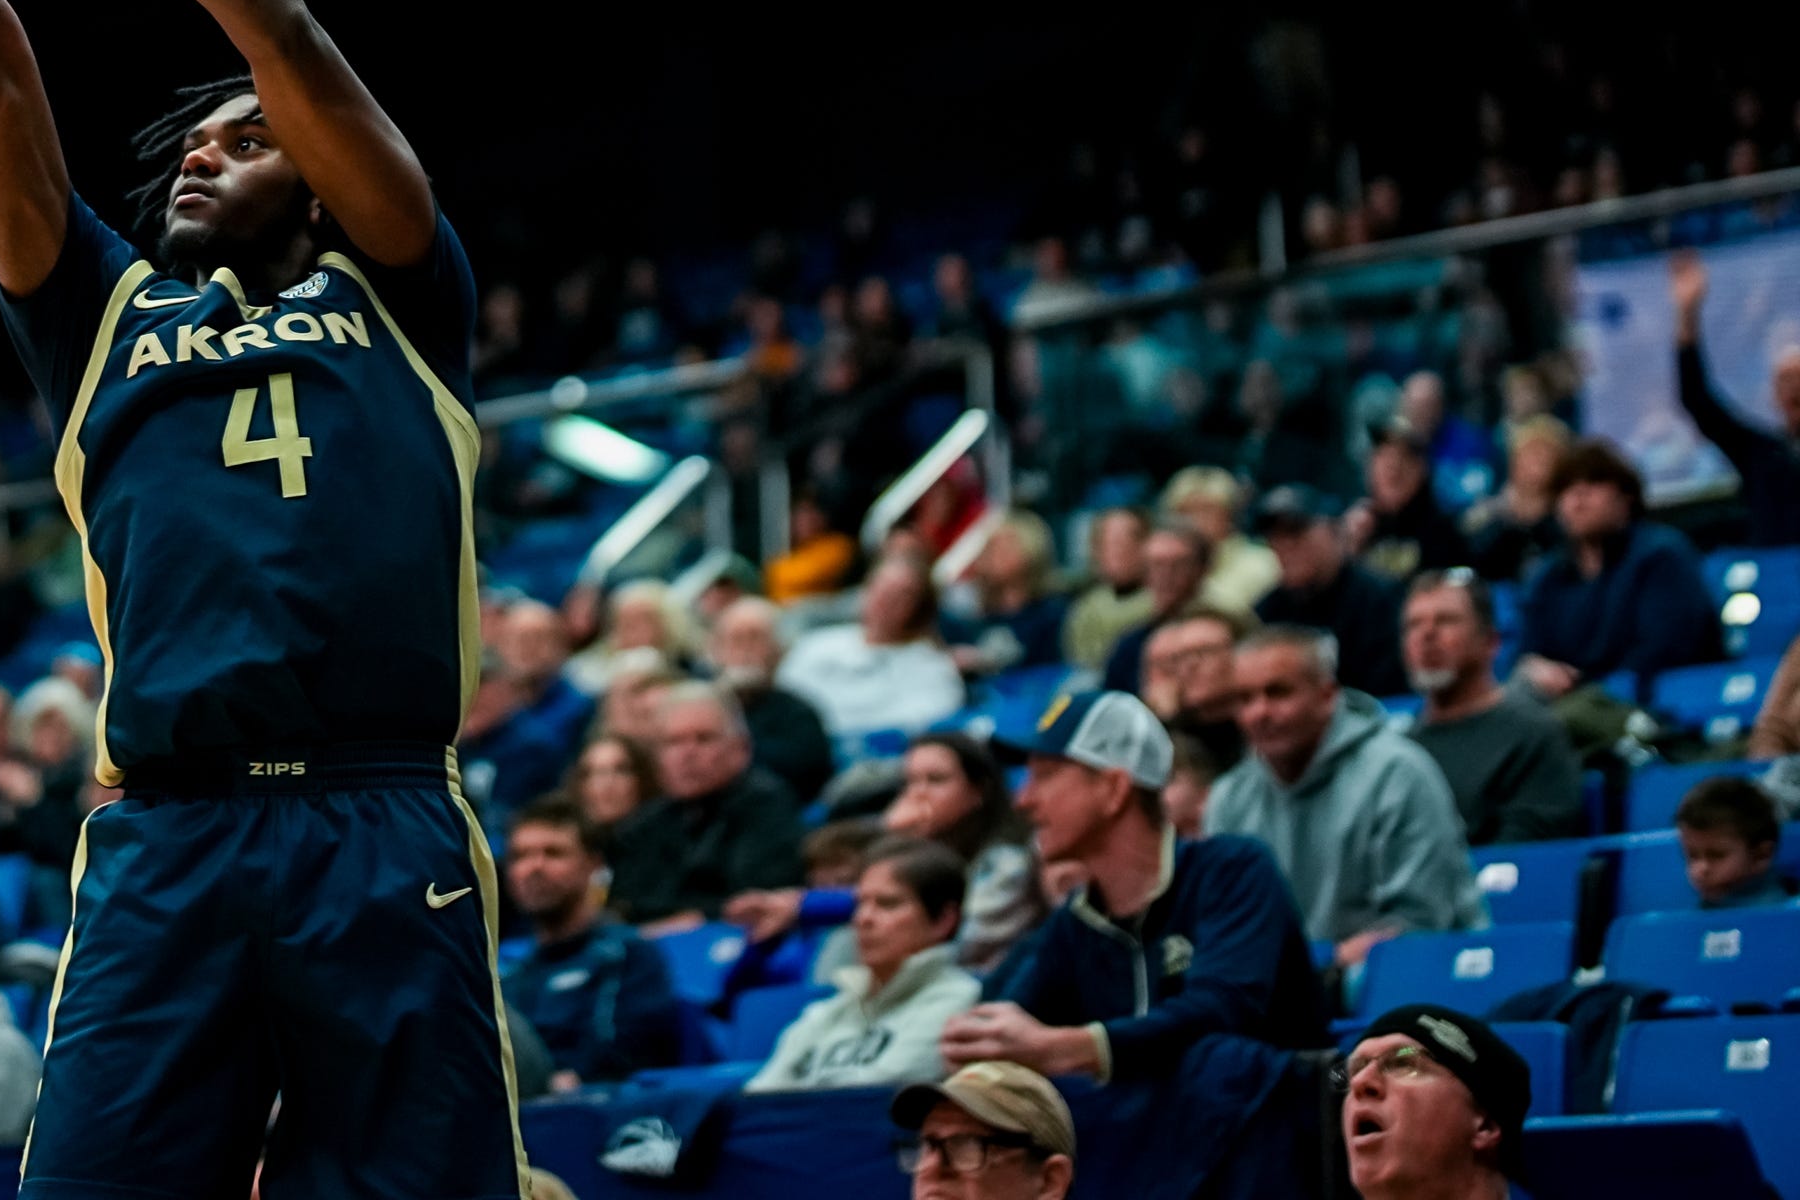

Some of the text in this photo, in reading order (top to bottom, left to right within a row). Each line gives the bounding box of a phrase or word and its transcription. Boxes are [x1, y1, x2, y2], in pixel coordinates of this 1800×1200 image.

[126, 312, 371, 379] AKRON
[222, 372, 313, 498] 4
[249, 762, 306, 775] ZIPS
